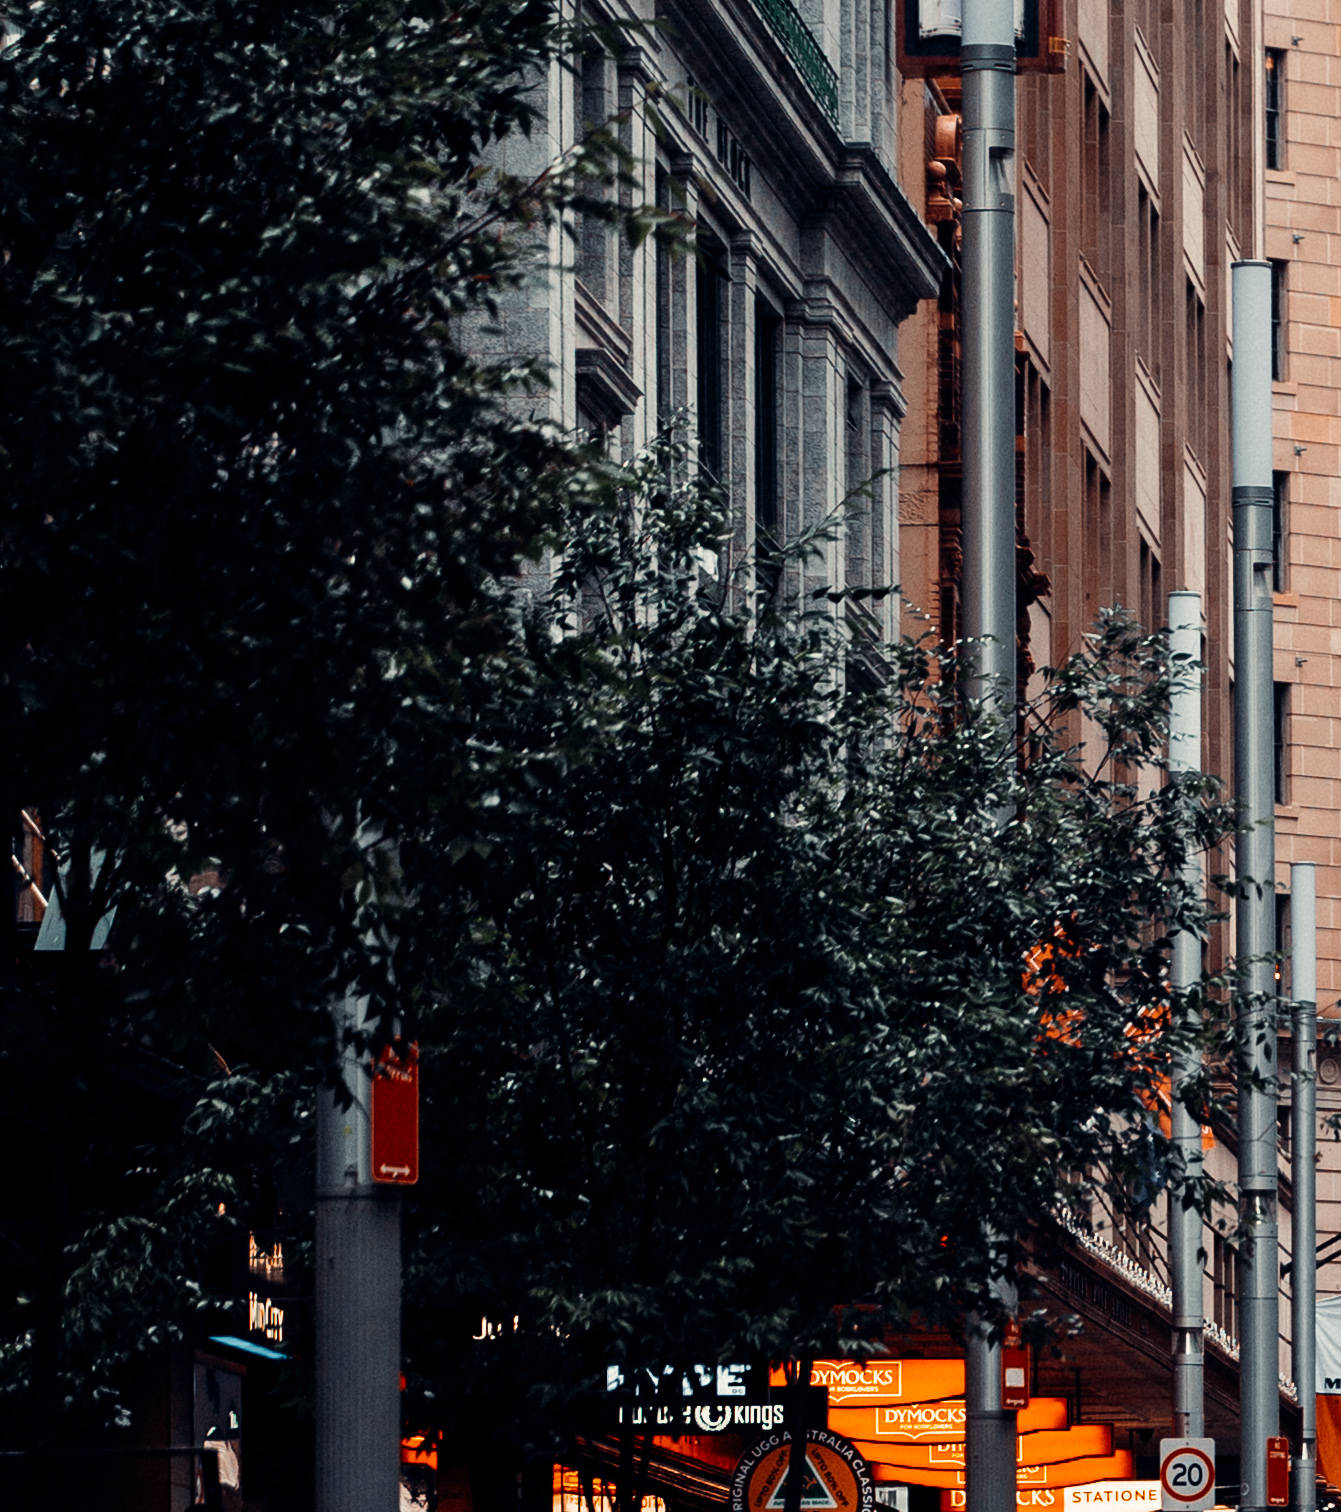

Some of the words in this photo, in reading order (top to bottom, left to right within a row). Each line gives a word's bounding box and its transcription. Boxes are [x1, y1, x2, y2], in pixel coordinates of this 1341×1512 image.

[810, 1370, 892, 1385] DYMOCKS
[734, 1404, 784, 1431] kings
[885, 1408, 966, 1424] DYMOCKS
[752, 1434, 779, 1457] UGG
[783, 1430, 855, 1460] ATRALIA
[1172, 1463, 1203, 1486] 20
[950, 1489, 1055, 1507] DCKS
[1072, 1489, 1156, 1503] STATIONE
